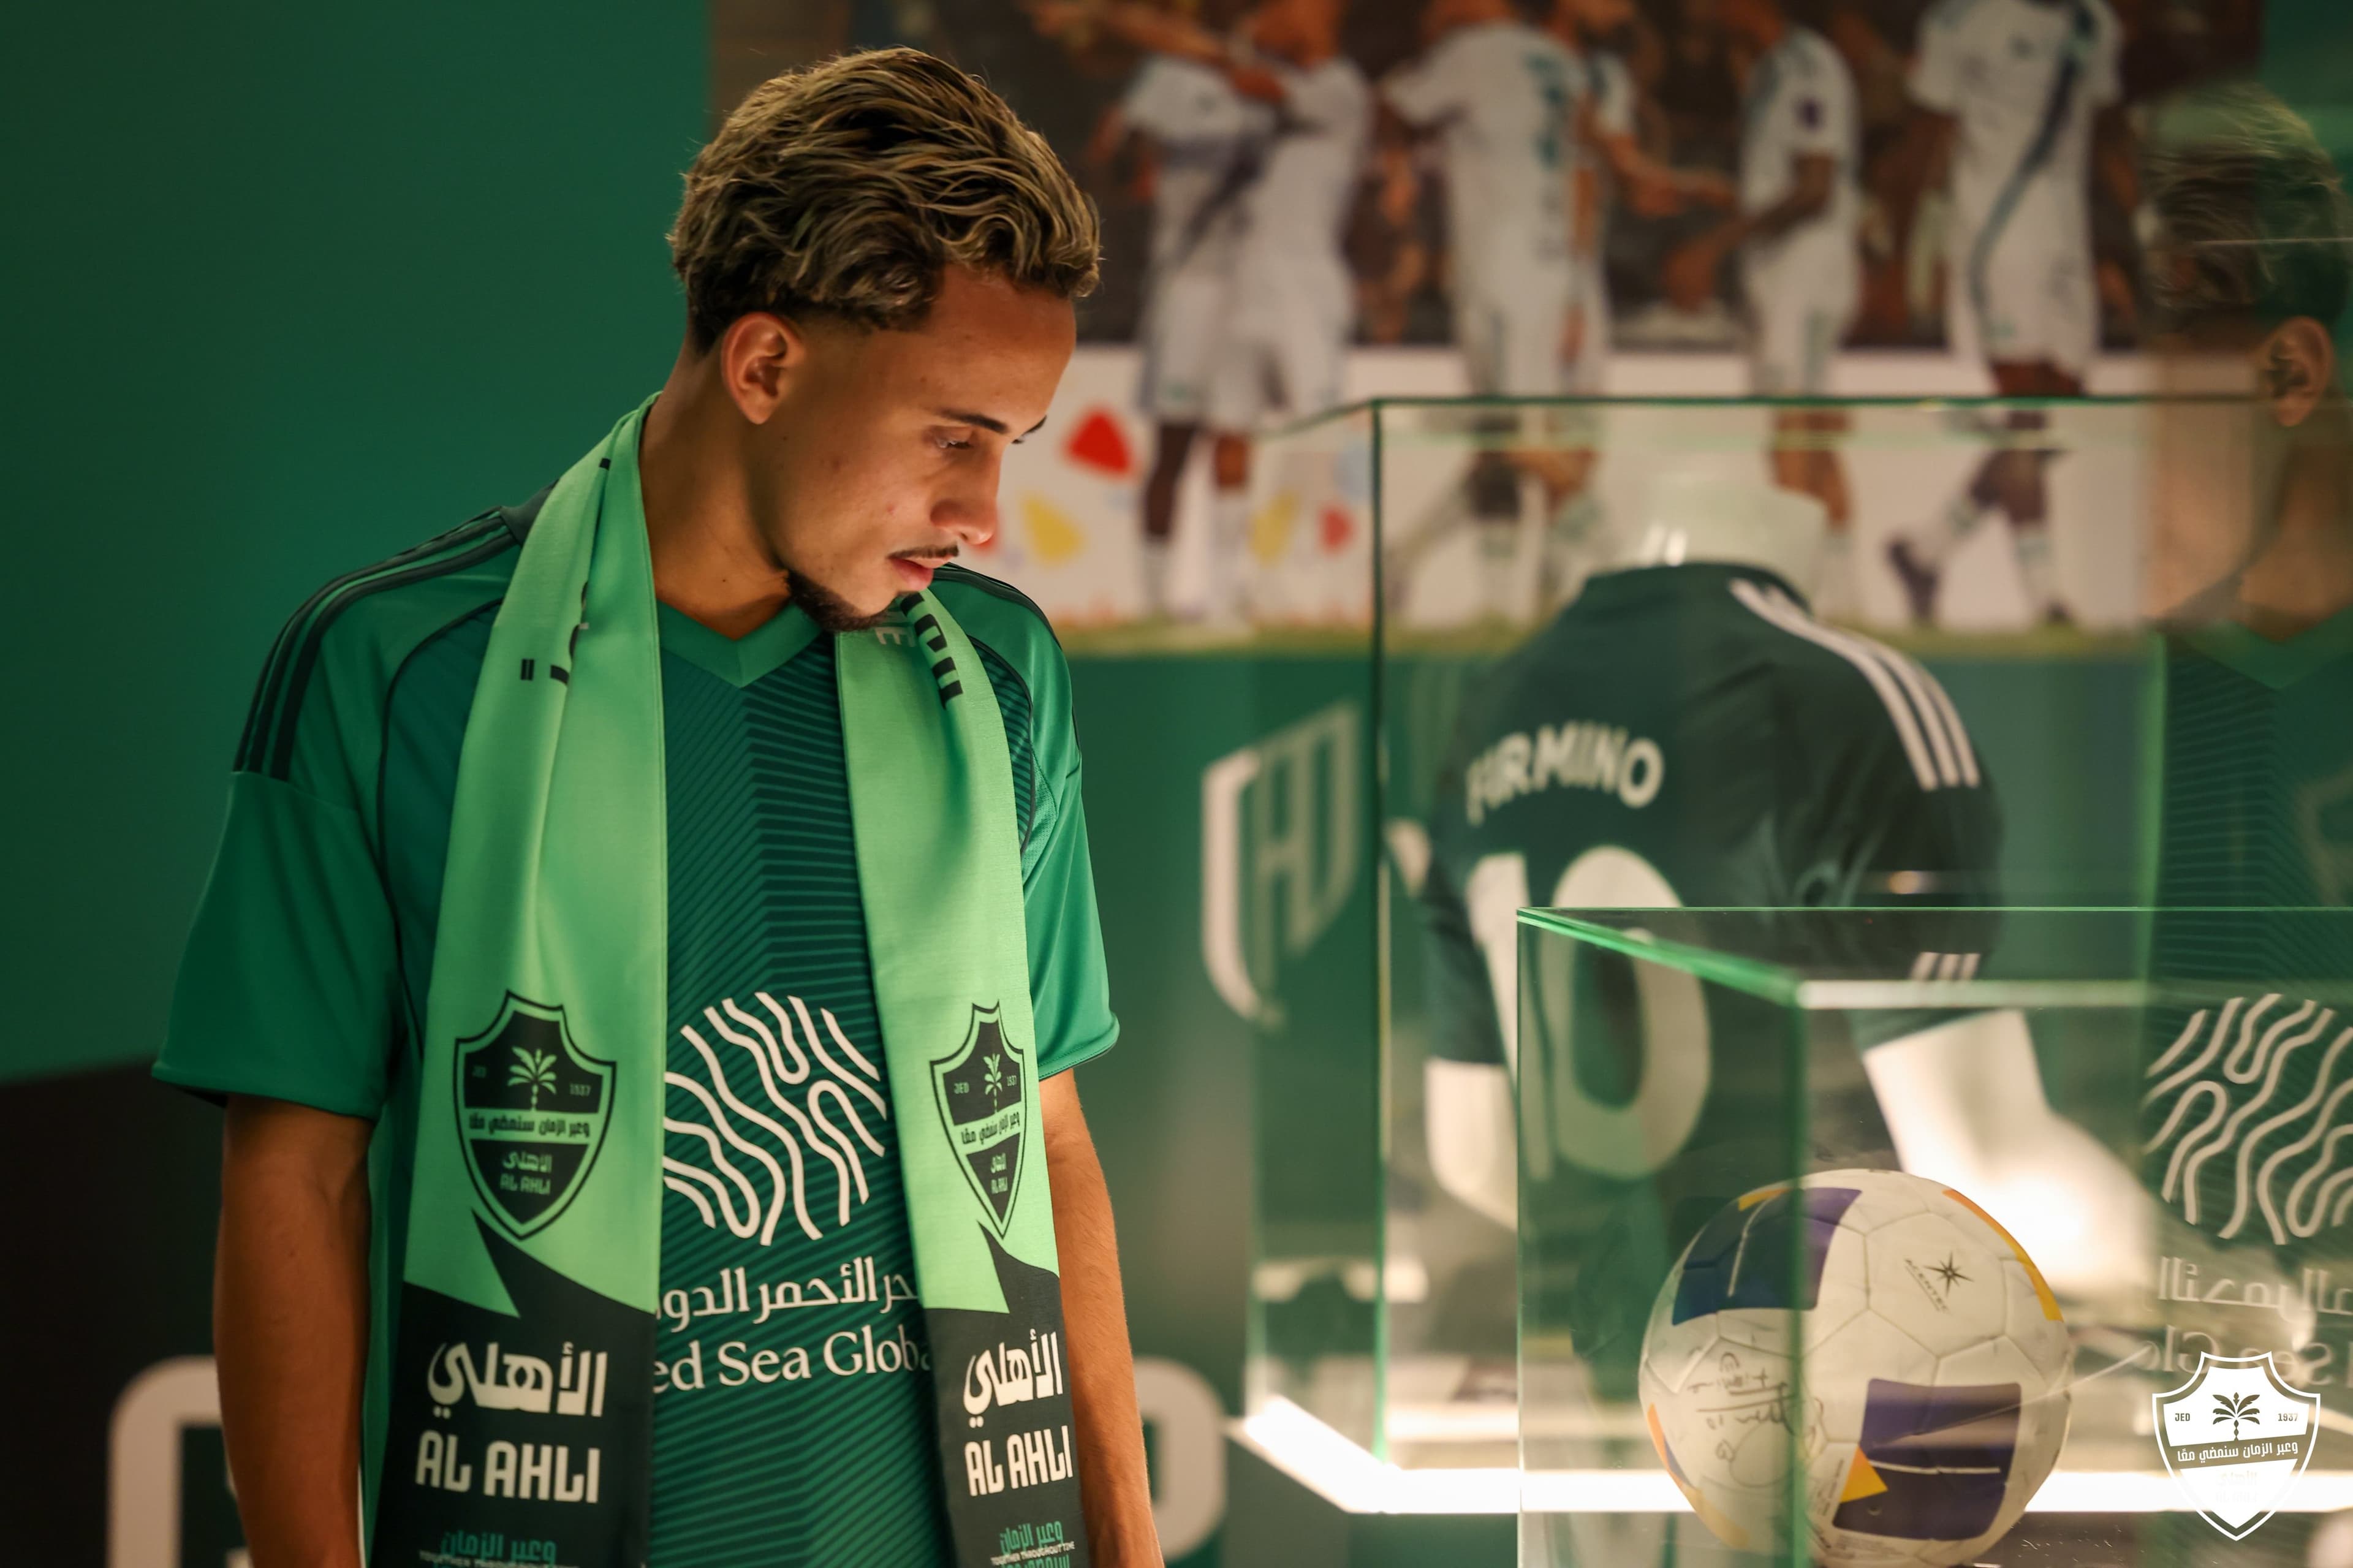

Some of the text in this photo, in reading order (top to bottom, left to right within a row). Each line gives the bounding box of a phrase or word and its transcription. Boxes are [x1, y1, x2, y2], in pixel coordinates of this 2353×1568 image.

[1468, 721, 1663, 825] FIRMINO
[1467, 845, 1711, 1181] 10
[953, 1081, 969, 1094] JED
[655, 1256, 919, 1333] حر الأحمر الدو
[427, 1341, 608, 1420] الأهلي
[652, 1324, 931, 1394] ed Sea Glob
[963, 1328, 1063, 1429] الأهلي
[415, 1430, 601, 1504] AL AHLI
[964, 1425, 1074, 1497] AL AHLI
[999, 1523, 1034, 1556] الزمان
